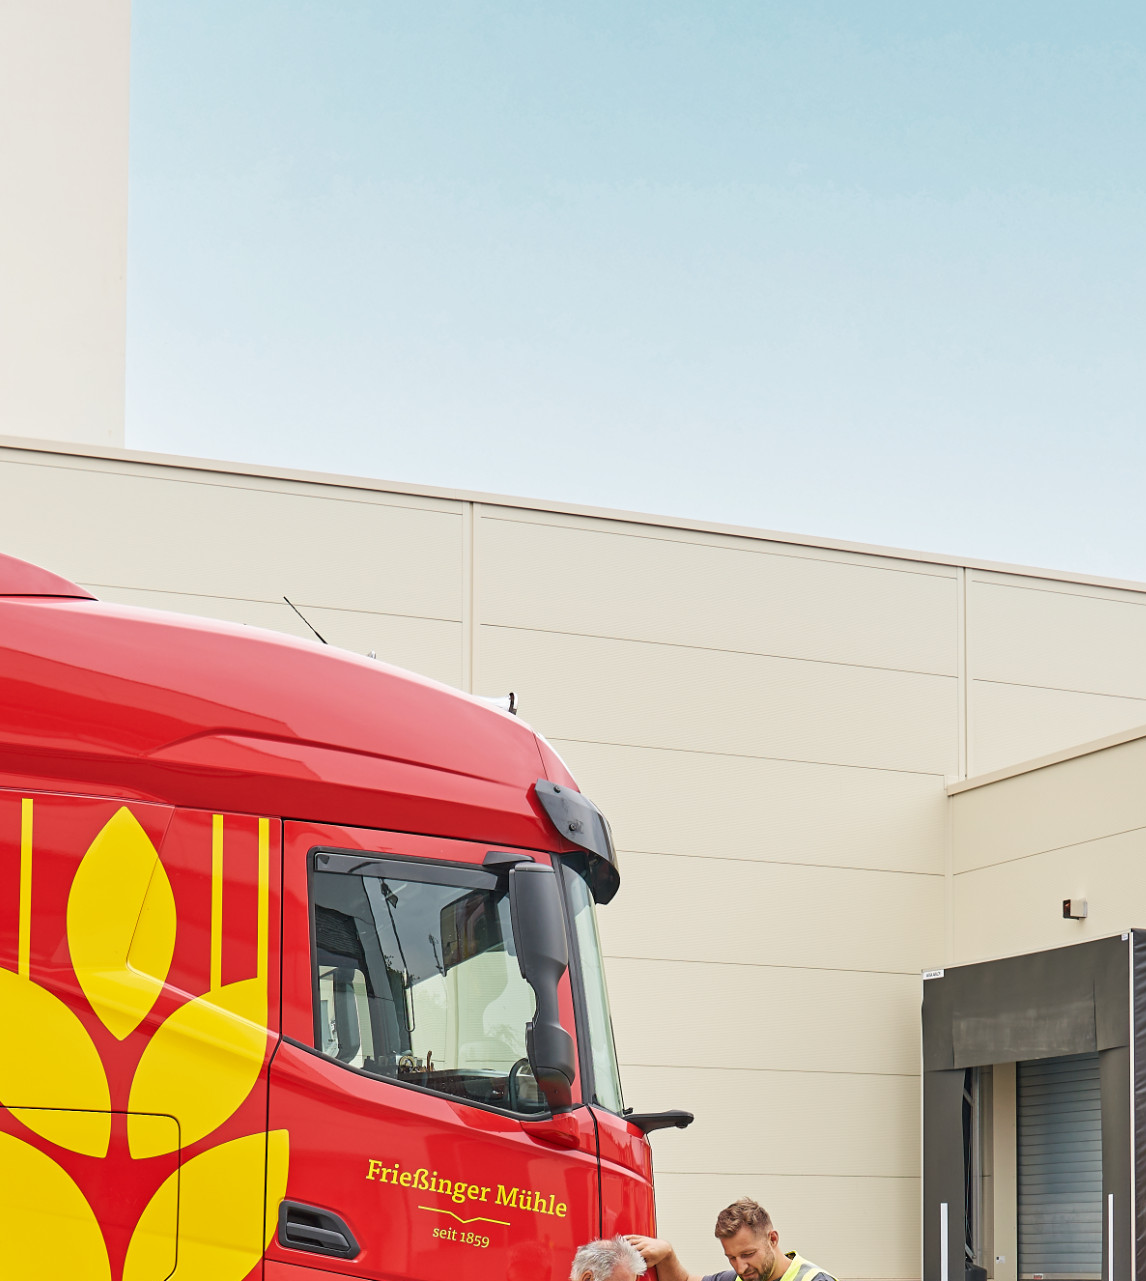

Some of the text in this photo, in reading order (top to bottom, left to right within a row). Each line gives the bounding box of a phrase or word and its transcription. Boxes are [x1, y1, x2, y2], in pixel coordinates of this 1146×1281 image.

[365, 1159, 568, 1218] Frießinger Mühle
[432, 1227, 490, 1248] seit 1859
